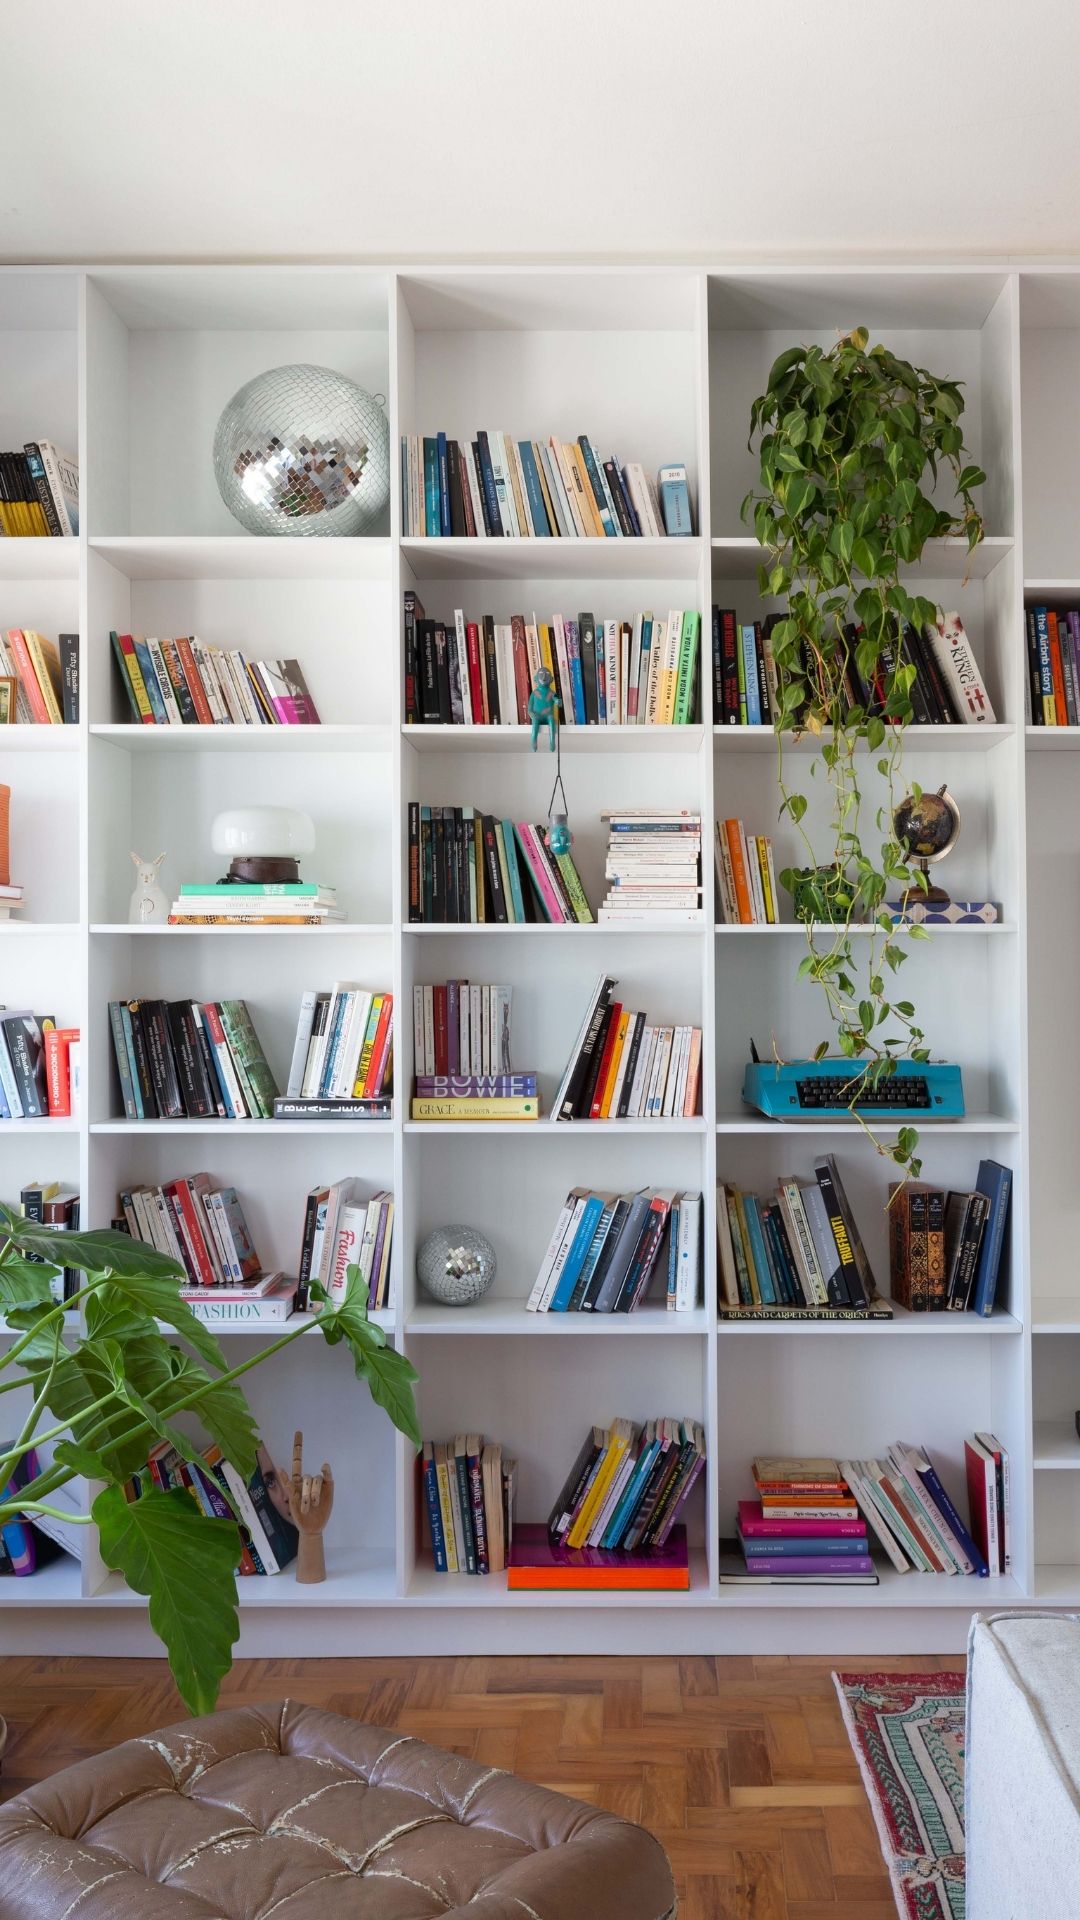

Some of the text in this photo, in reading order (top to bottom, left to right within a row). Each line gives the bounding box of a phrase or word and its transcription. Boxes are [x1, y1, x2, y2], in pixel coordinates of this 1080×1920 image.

[37, 479, 57, 526] FRANCESES
[724, 614, 735, 657] STEPHEN KING
[180, 642, 192, 667] Educated
[744, 634, 753, 672] STEPHEN
[951, 648, 970, 684] KING
[957, 646, 976, 681] STEPHEN
[1037, 614, 1051, 692] the Airbnb story
[151, 651, 172, 699] INVISIBLE CIRCUS
[609, 673, 616, 681] OF
[649, 646, 661, 716] Valley of the Dolls
[747, 672, 755, 694] KING
[760, 660, 768, 708] ENCLAUSURADO
[180, 1045, 188, 1060] palacio
[363, 1044, 373, 1056] GIRL
[584, 1045, 592, 1054] LES
[21, 1052, 29, 1075] Shades
[357, 1069, 367, 1083] BAND
[434, 1076, 524, 1087] BOWIE
[434, 1087, 524, 1097] BOWIE
[420, 1105, 455, 1115] GRACE
[831, 1220, 855, 1265] TRUFFAUT
[332, 1230, 356, 1289] Fashion
[959, 1241, 970, 1276] DE CONCHAS
[964, 1243, 977, 1284] OS CATADORES
[192, 1303, 261, 1319] FASHION
[428, 1486, 436, 1502] Cline
[475, 1509, 484, 1536] GLENNON
[915, 1486, 934, 1509] ALEXA
[931, 1509, 948, 1534] CHUNG
[431, 1524, 441, 1546] garotas
[477, 1537, 485, 1556] DOYLE
